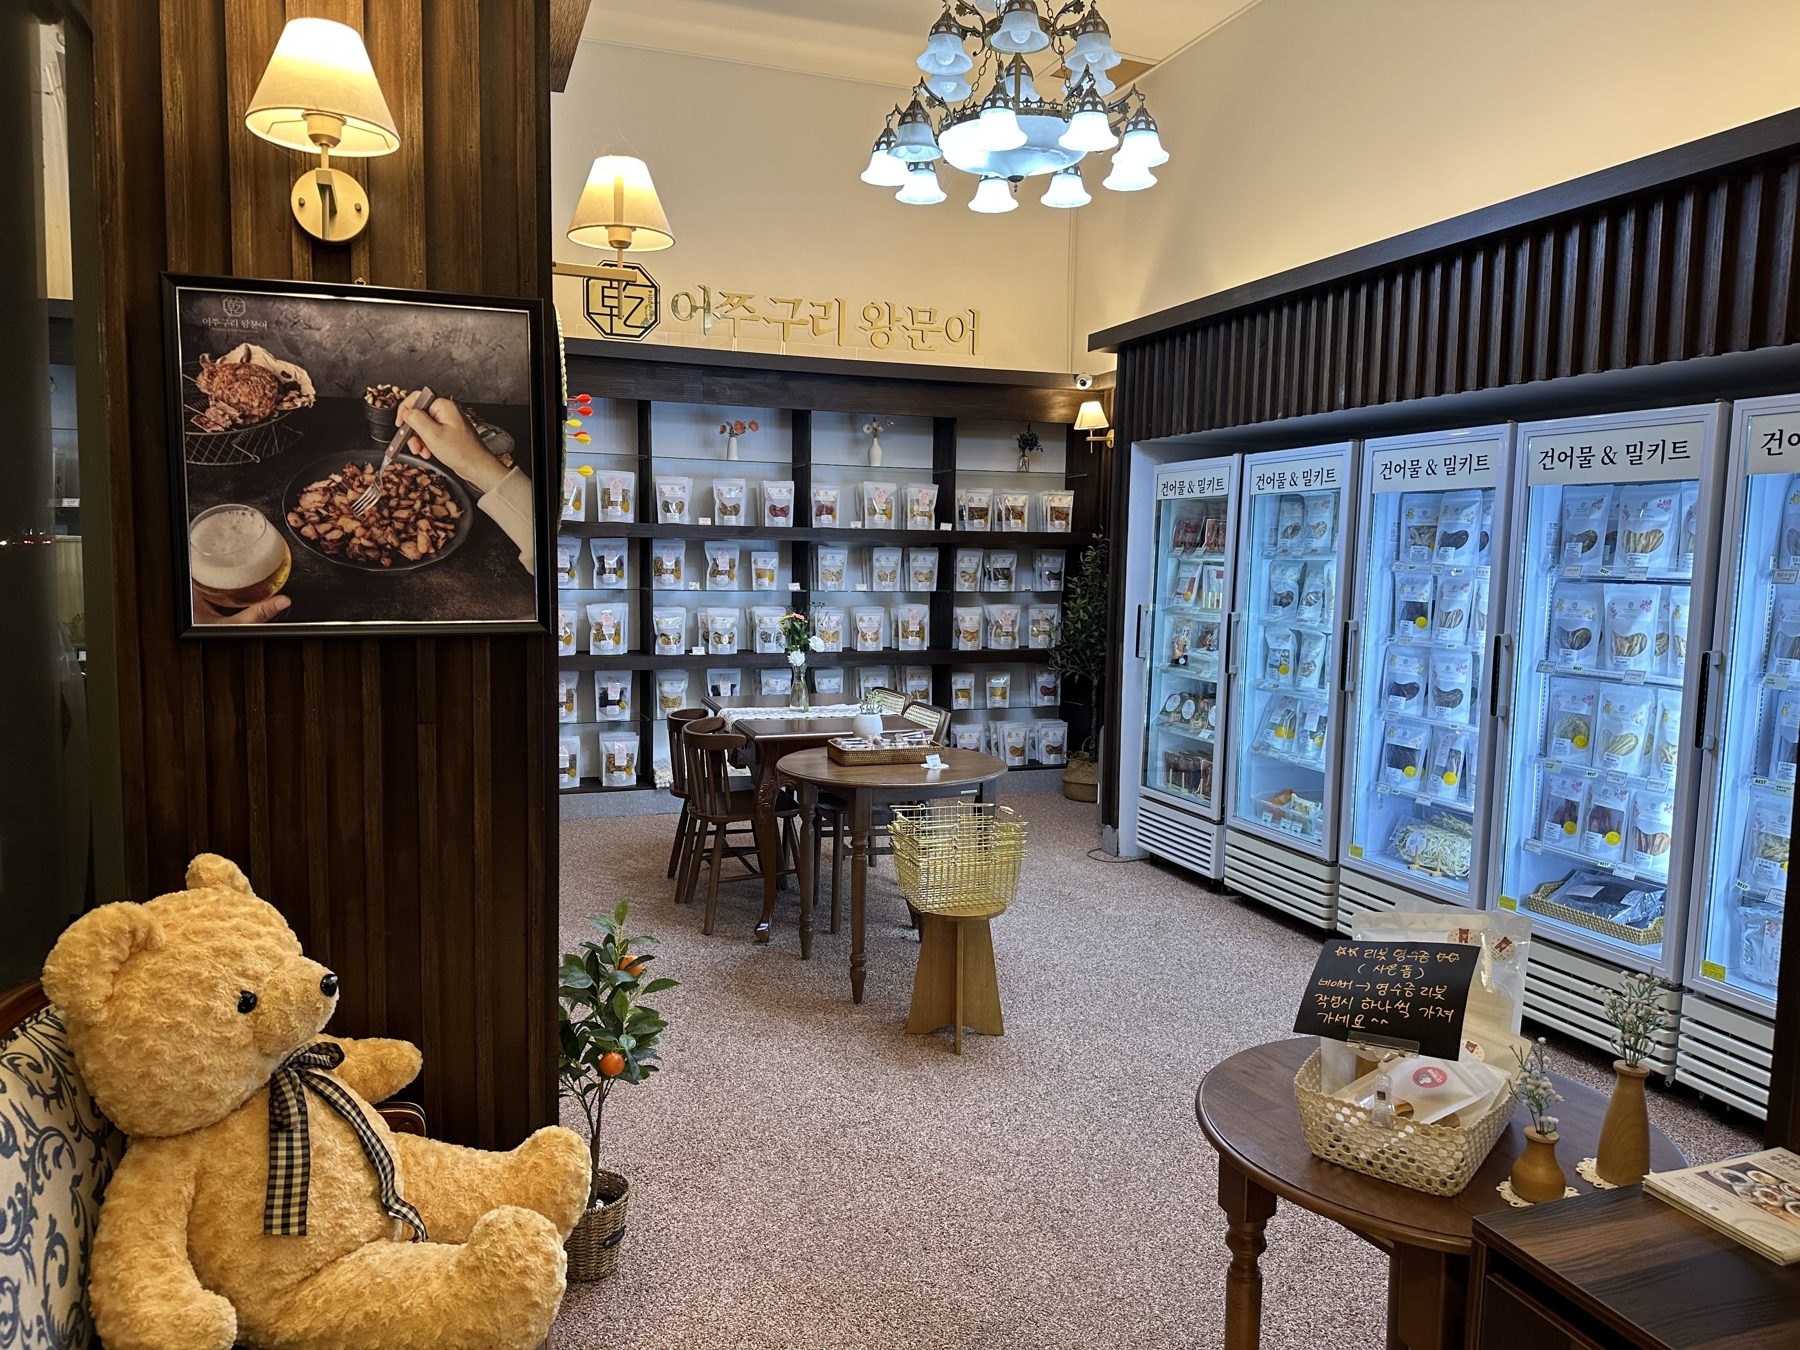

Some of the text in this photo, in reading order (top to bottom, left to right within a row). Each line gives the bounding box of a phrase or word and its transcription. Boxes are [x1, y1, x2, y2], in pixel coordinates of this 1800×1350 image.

[670, 284, 981, 356] 어쭈구리 왕문어
[1380, 453, 1490, 480] 건어물 & 밀키트
[1538, 439, 1691, 471] 건어물 & 밀키트
[1161, 476, 1225, 497] 건어물 & 밀키트
[1256, 467, 1337, 491] 건어물 & 밀키트
[1393, 948, 1431, 964] 영수증
[1376, 981, 1416, 998] 영수증
